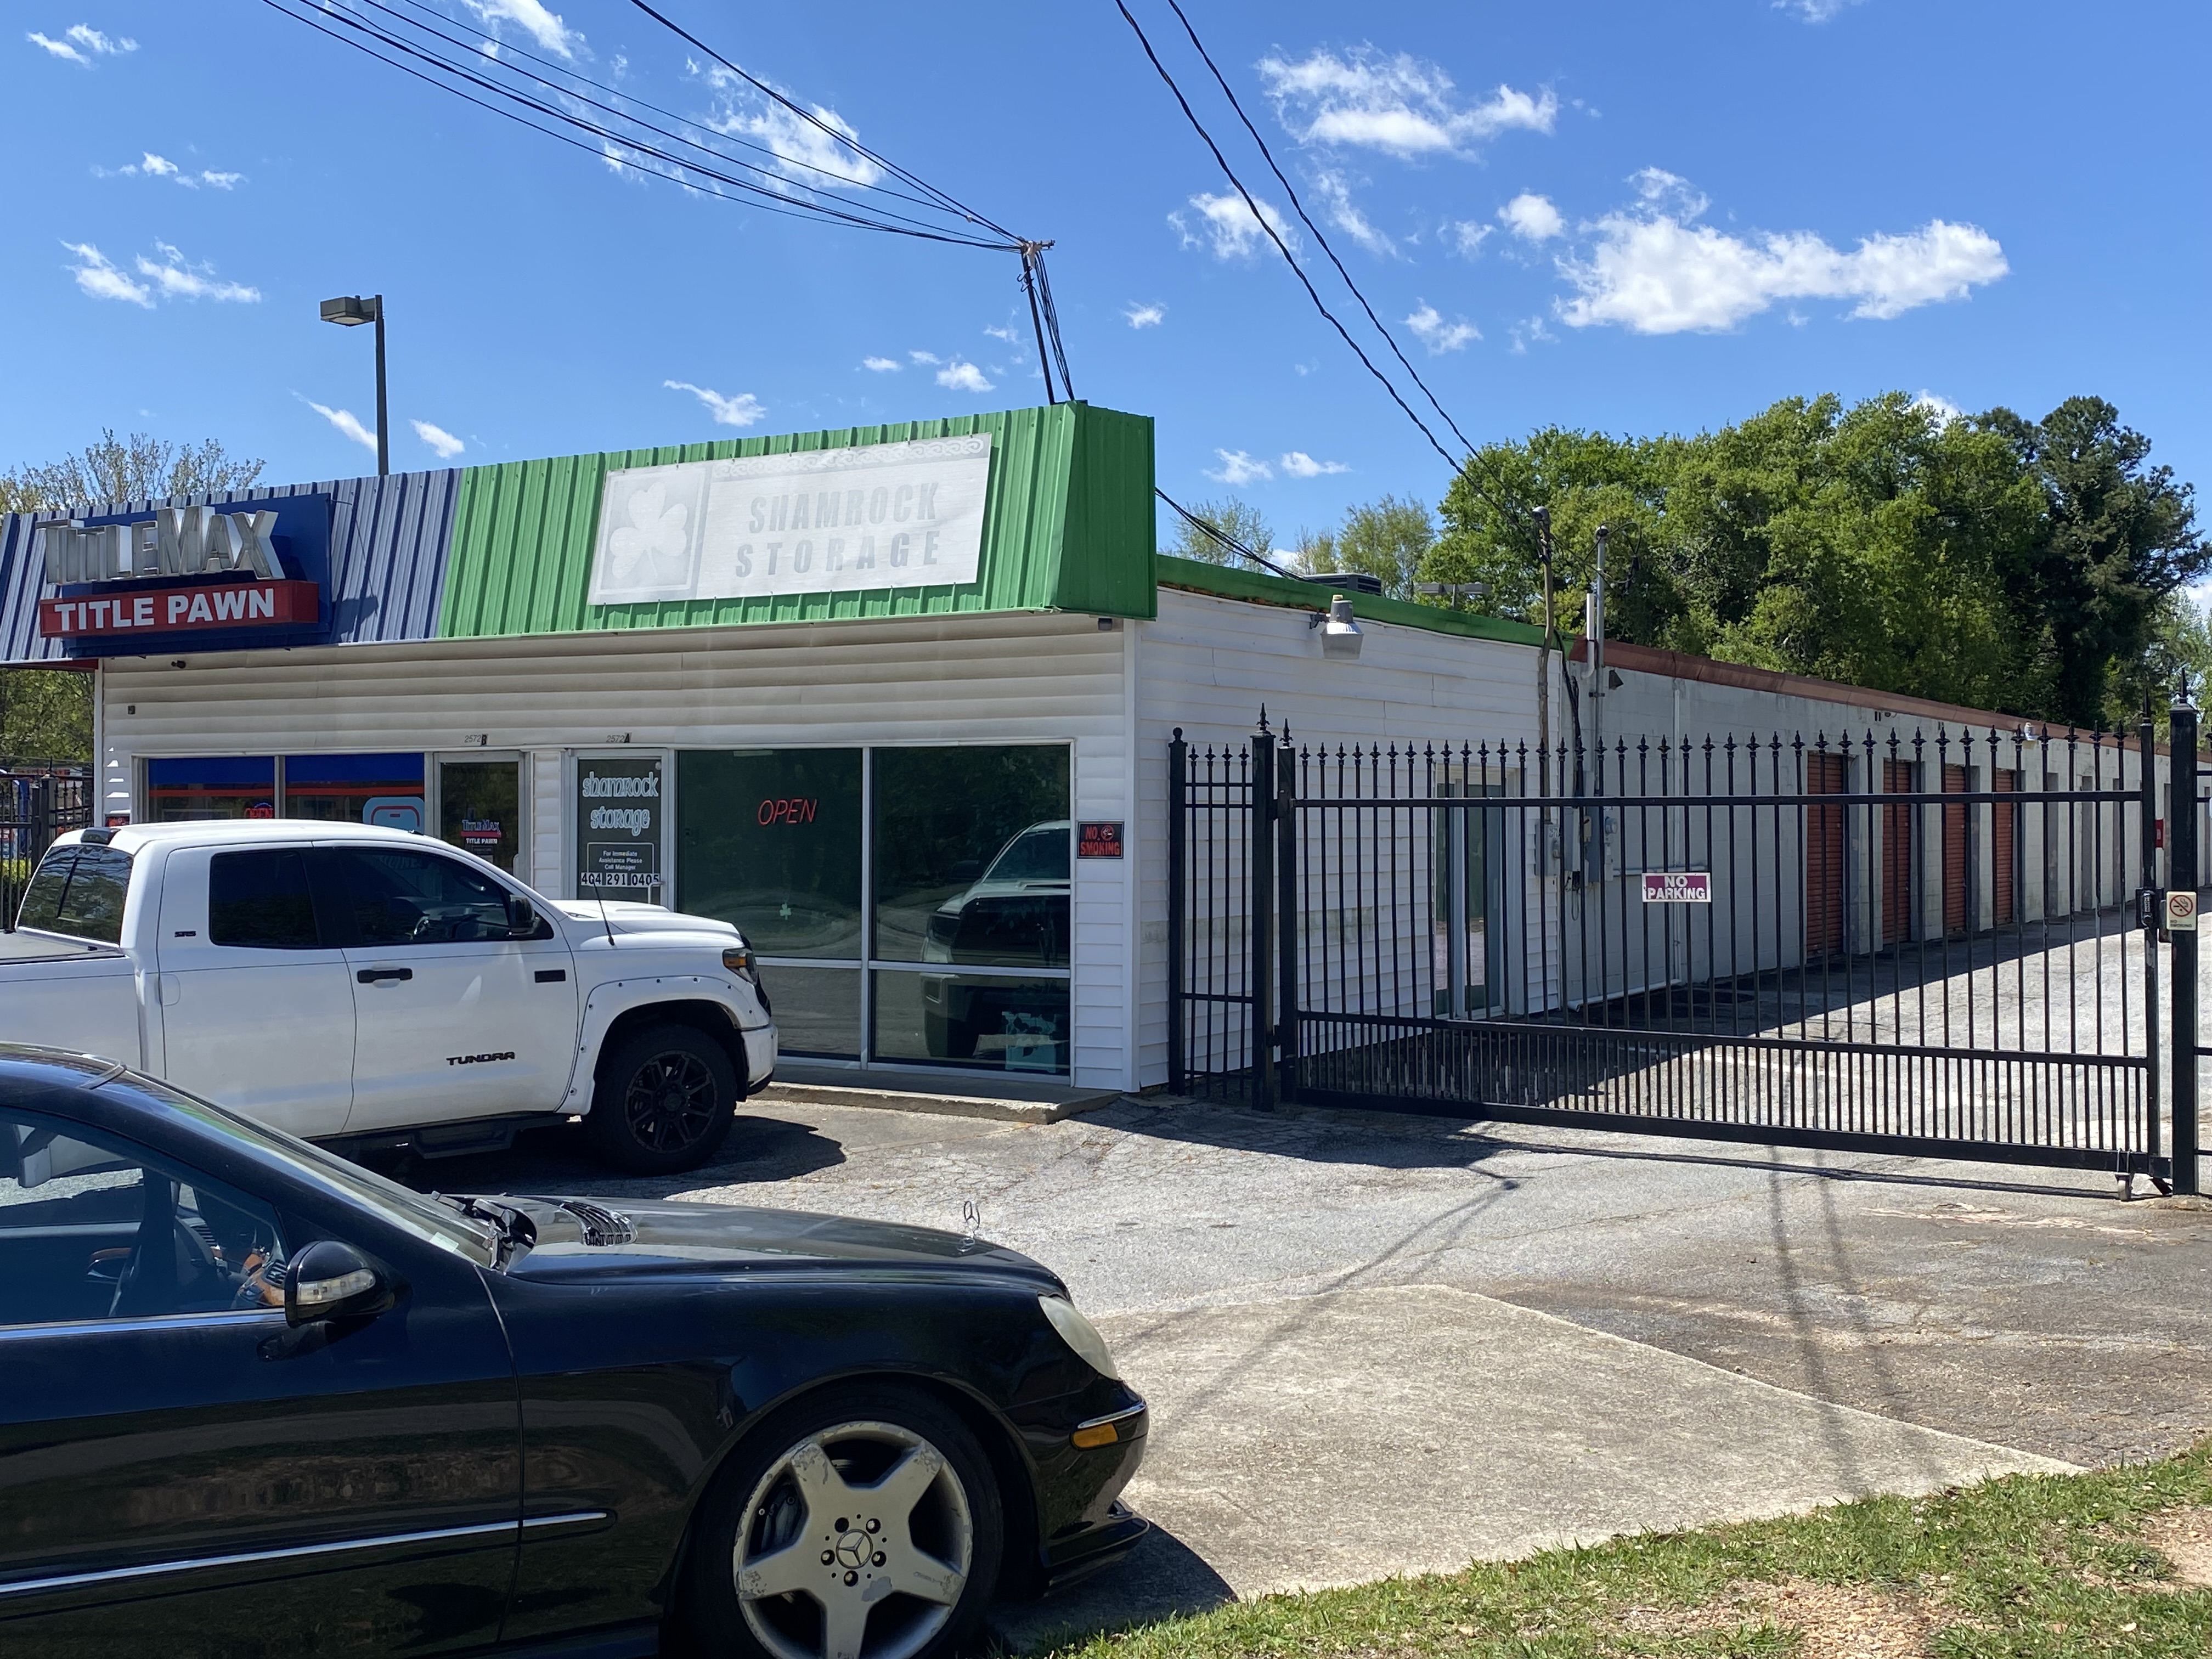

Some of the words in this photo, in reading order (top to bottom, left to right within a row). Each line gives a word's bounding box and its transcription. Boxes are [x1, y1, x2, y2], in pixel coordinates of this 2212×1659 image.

[749, 482, 939, 533] SHAMROCK
[735, 530, 940, 578] STORAGE
[55, 596, 155, 631] TITLE
[167, 588, 274, 624] PAWN
[758, 798, 817, 826] OPEN
[1085, 825, 1098, 840] NO
[1080, 841, 1120, 856] SMOKING
[582, 873, 601, 885] 404
[607, 873, 627, 885] 291
[1664, 876, 1688, 888] NO
[1647, 887, 1706, 899] PARKING
[445, 1051, 515, 1066] TUNDRA
